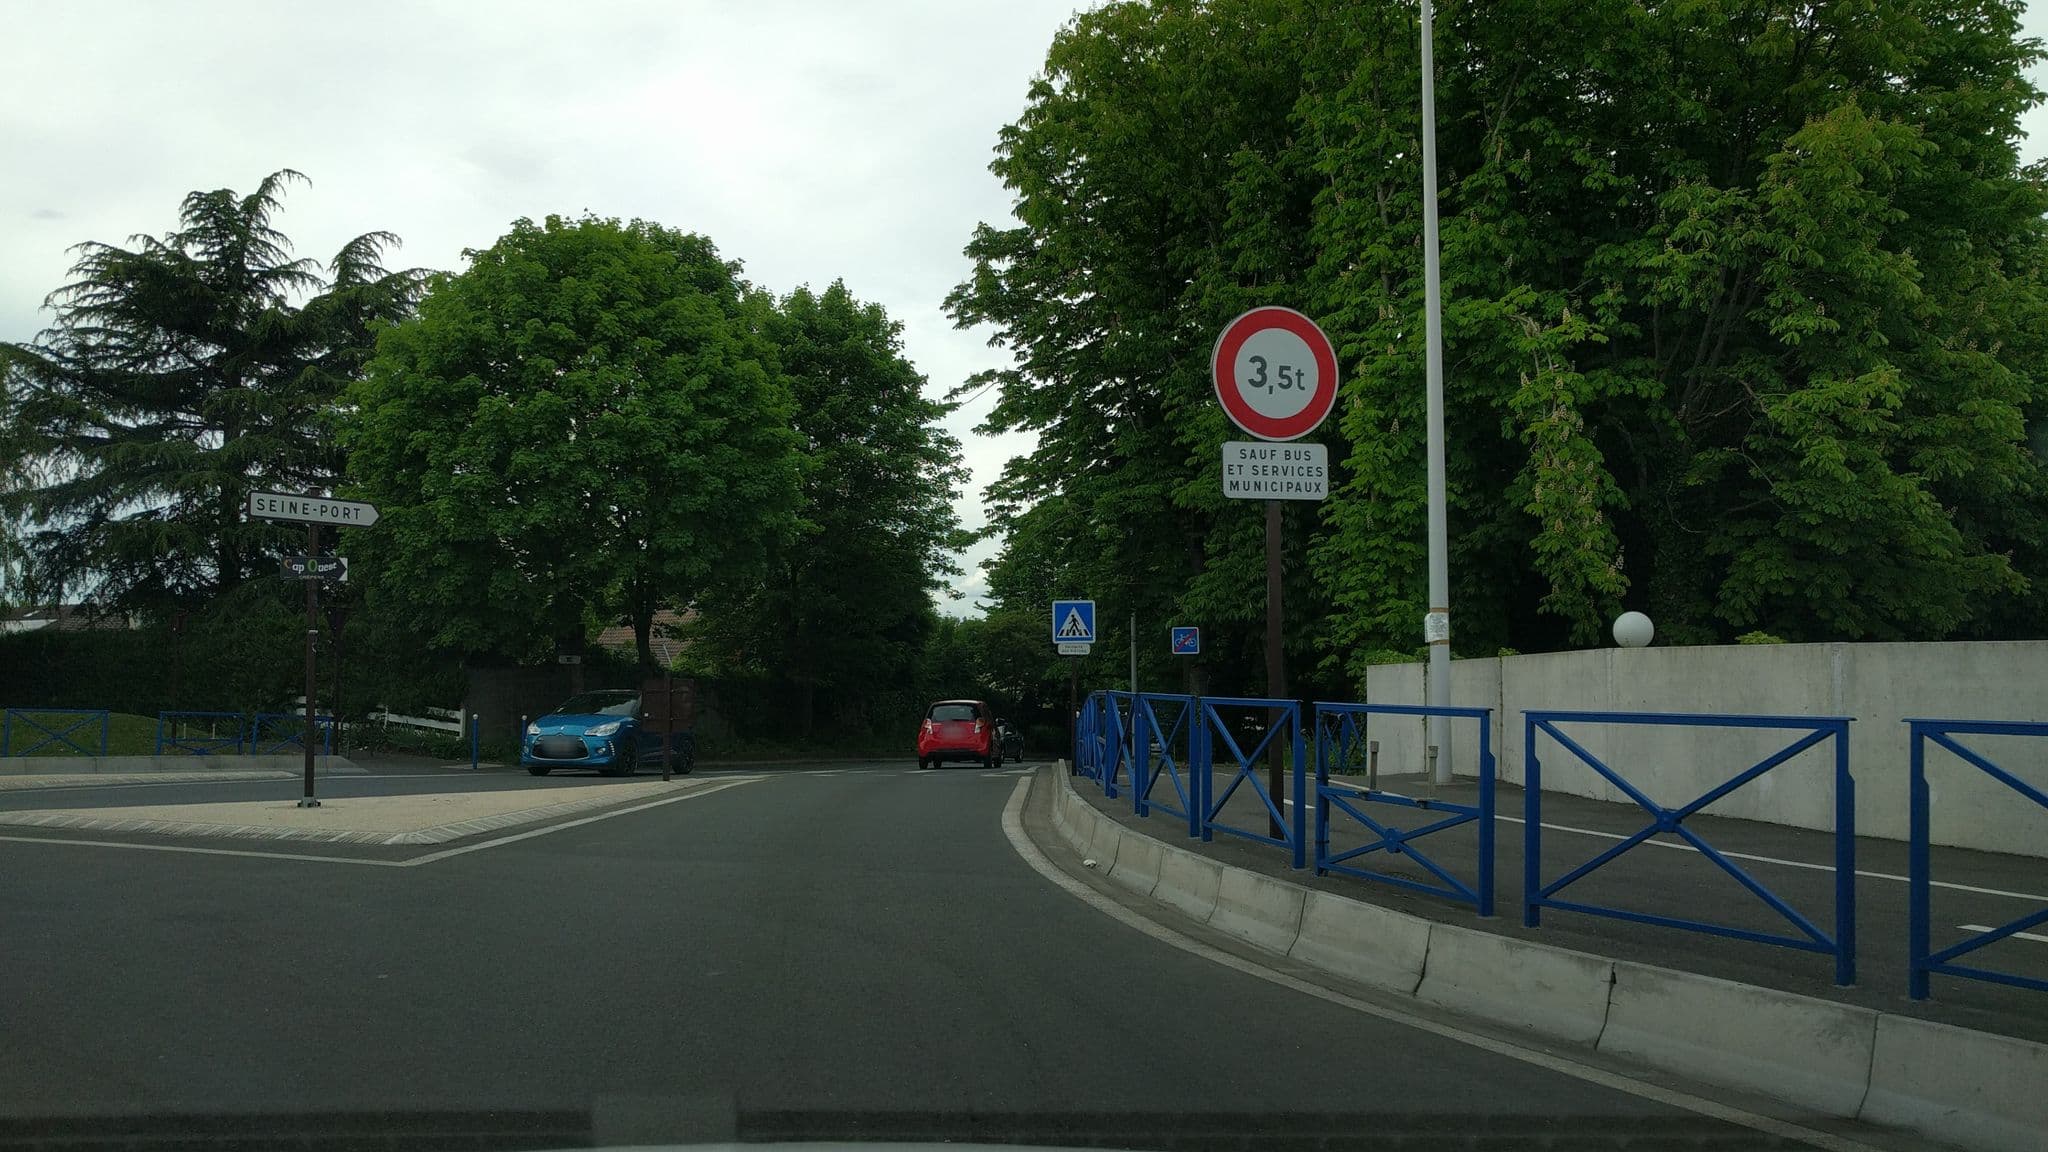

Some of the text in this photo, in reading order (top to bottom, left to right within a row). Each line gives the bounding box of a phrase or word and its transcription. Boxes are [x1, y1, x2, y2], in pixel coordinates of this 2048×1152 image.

[1247, 355, 1306, 395] 3,5t
[1239, 448, 1312, 462] SAUF BUS
[1227, 464, 1324, 478] ET SERVICES
[1229, 480, 1322, 493] MUNICIPAUX
[256, 498, 361, 520] SEINE-PORT
